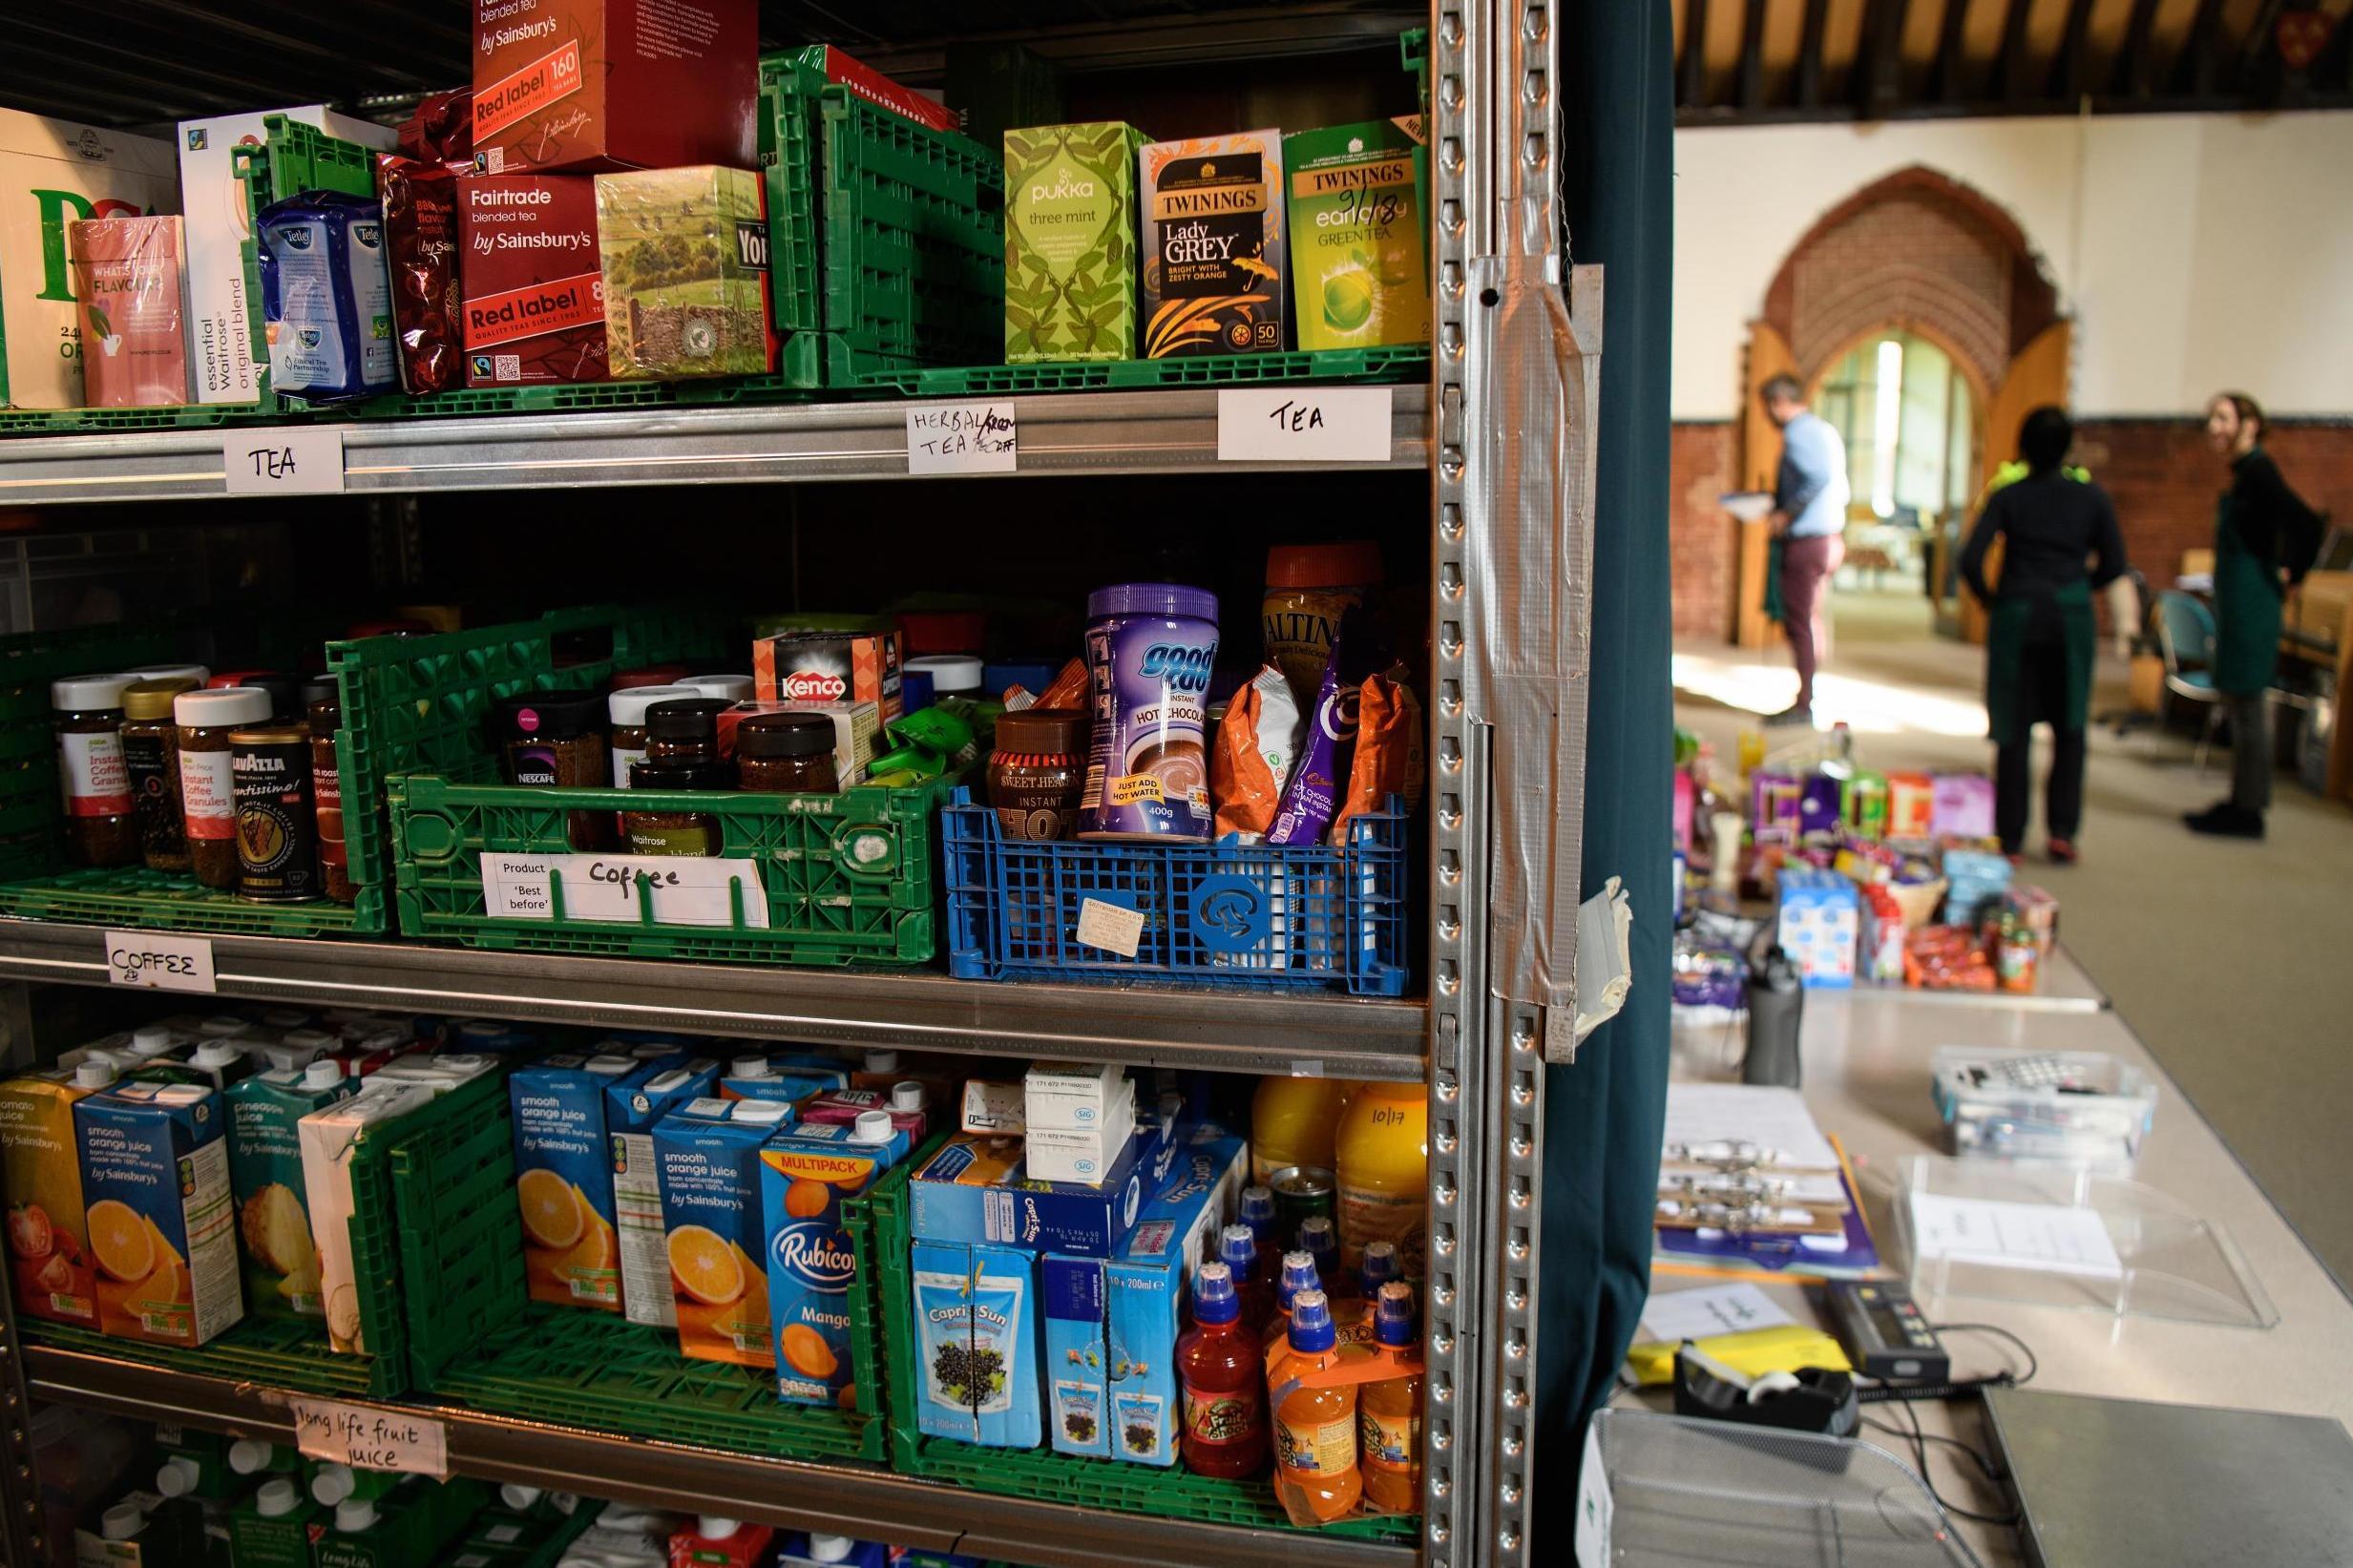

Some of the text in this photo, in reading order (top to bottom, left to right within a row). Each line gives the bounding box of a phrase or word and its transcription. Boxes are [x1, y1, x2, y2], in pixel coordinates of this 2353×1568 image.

[481, 4, 518, 24] blended
[481, 15, 557, 55] by Sainsbury's
[551, 52, 576, 79] 160
[475, 70, 544, 123] Red label
[1313, 163, 1404, 191] TWININGS
[471, 188, 552, 206] Fairtrade
[1032, 176, 1094, 205] pukka
[1163, 190, 1257, 214] TWININGS
[472, 211, 536, 223] blended tea
[1029, 210, 1097, 225] three mint
[286, 229, 310, 246] Tetley
[1166, 220, 1209, 243] Lady
[1318, 228, 1394, 246] GREEN TEA
[473, 233, 494, 255] by
[496, 231, 592, 254] Sainsbury's
[1168, 263, 1221, 275] BRIGHT WITH
[1168, 270, 1228, 282] ZESTY ORANGE
[471, 288, 578, 329] Red label
[229, 277, 249, 389] original blend
[1258, 324, 1275, 339] 50
[201, 318, 218, 392] essential
[292, 365, 330, 373] Partnership
[1269, 400, 1325, 432] TEA
[919, 434, 967, 455] TEA
[248, 447, 296, 479] TEA
[1139, 639, 1218, 678] good
[781, 677, 847, 699] Kenco
[1169, 694, 1195, 704] INSTANT
[1136, 709, 1160, 725] HOT
[1000, 775, 1037, 788] SWEET
[1118, 778, 1158, 791] JUST ADD
[1019, 795, 1063, 807] INSTANT
[1112, 788, 1161, 802] HOT WATER
[1148, 806, 1174, 818] 400g
[631, 833, 666, 846] Waitrose
[503, 863, 546, 874] Product
[514, 885, 542, 897] 'Best
[510, 899, 549, 910] before'
[111, 948, 197, 977] COFFEE
[520, 1096, 560, 1107] smooth
[755, 1087, 788, 1098] smooth
[0, 1100, 35, 1112] omato
[521, 1107, 587, 1121] orange juice
[1372, 1106, 1405, 1126] 10/17
[87, 1126, 125, 1139] smooth
[14, 1135, 63, 1153] Sainsbury's
[89, 1138, 153, 1154] orange juice
[522, 1135, 590, 1155] by Sainsbury's
[664, 1153, 707, 1163] smooth
[780, 1155, 858, 1175] MULTIPACK
[92, 1166, 158, 1186] by Sainsbury's
[666, 1163, 738, 1179] orange juice
[670, 1192, 745, 1211] by Sainsbury's
[1127, 1278, 1152, 1290] 200ml
[801, 1305, 851, 1329] Mango
[297, 1405, 421, 1446] long life fruit
[344, 1440, 399, 1468] juice
